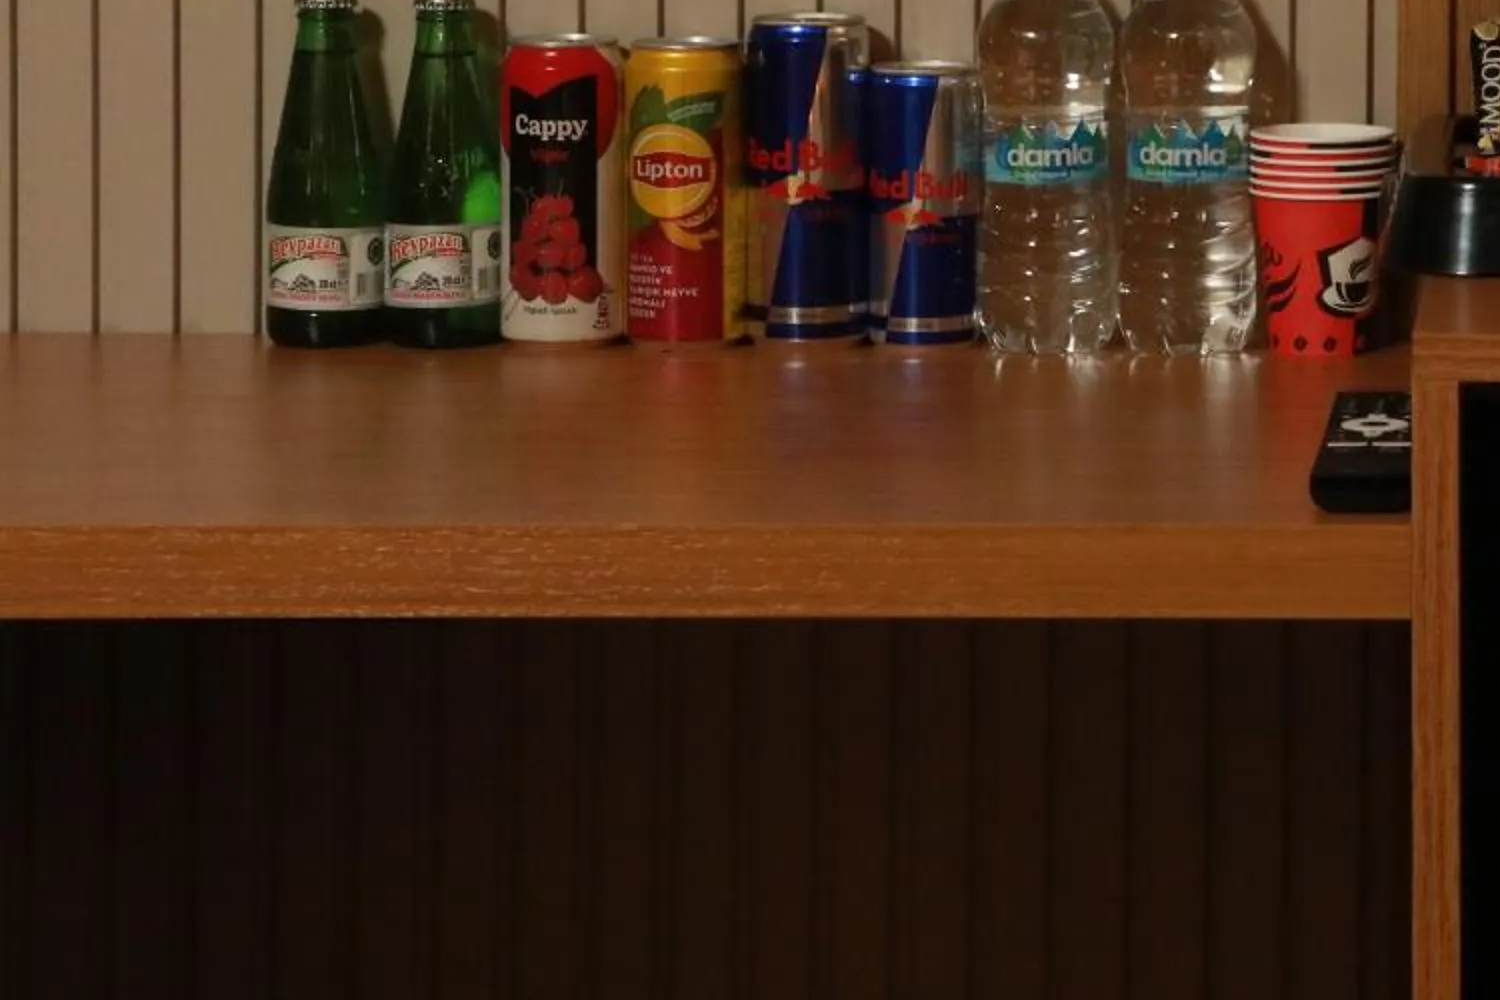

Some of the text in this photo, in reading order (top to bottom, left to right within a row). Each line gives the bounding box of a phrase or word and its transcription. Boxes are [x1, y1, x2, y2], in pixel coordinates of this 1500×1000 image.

[515, 113, 588, 141] Cappy
[1008, 143, 1093, 167] damla
[1140, 141, 1226, 167] damla
[637, 159, 703, 181] Lipton
